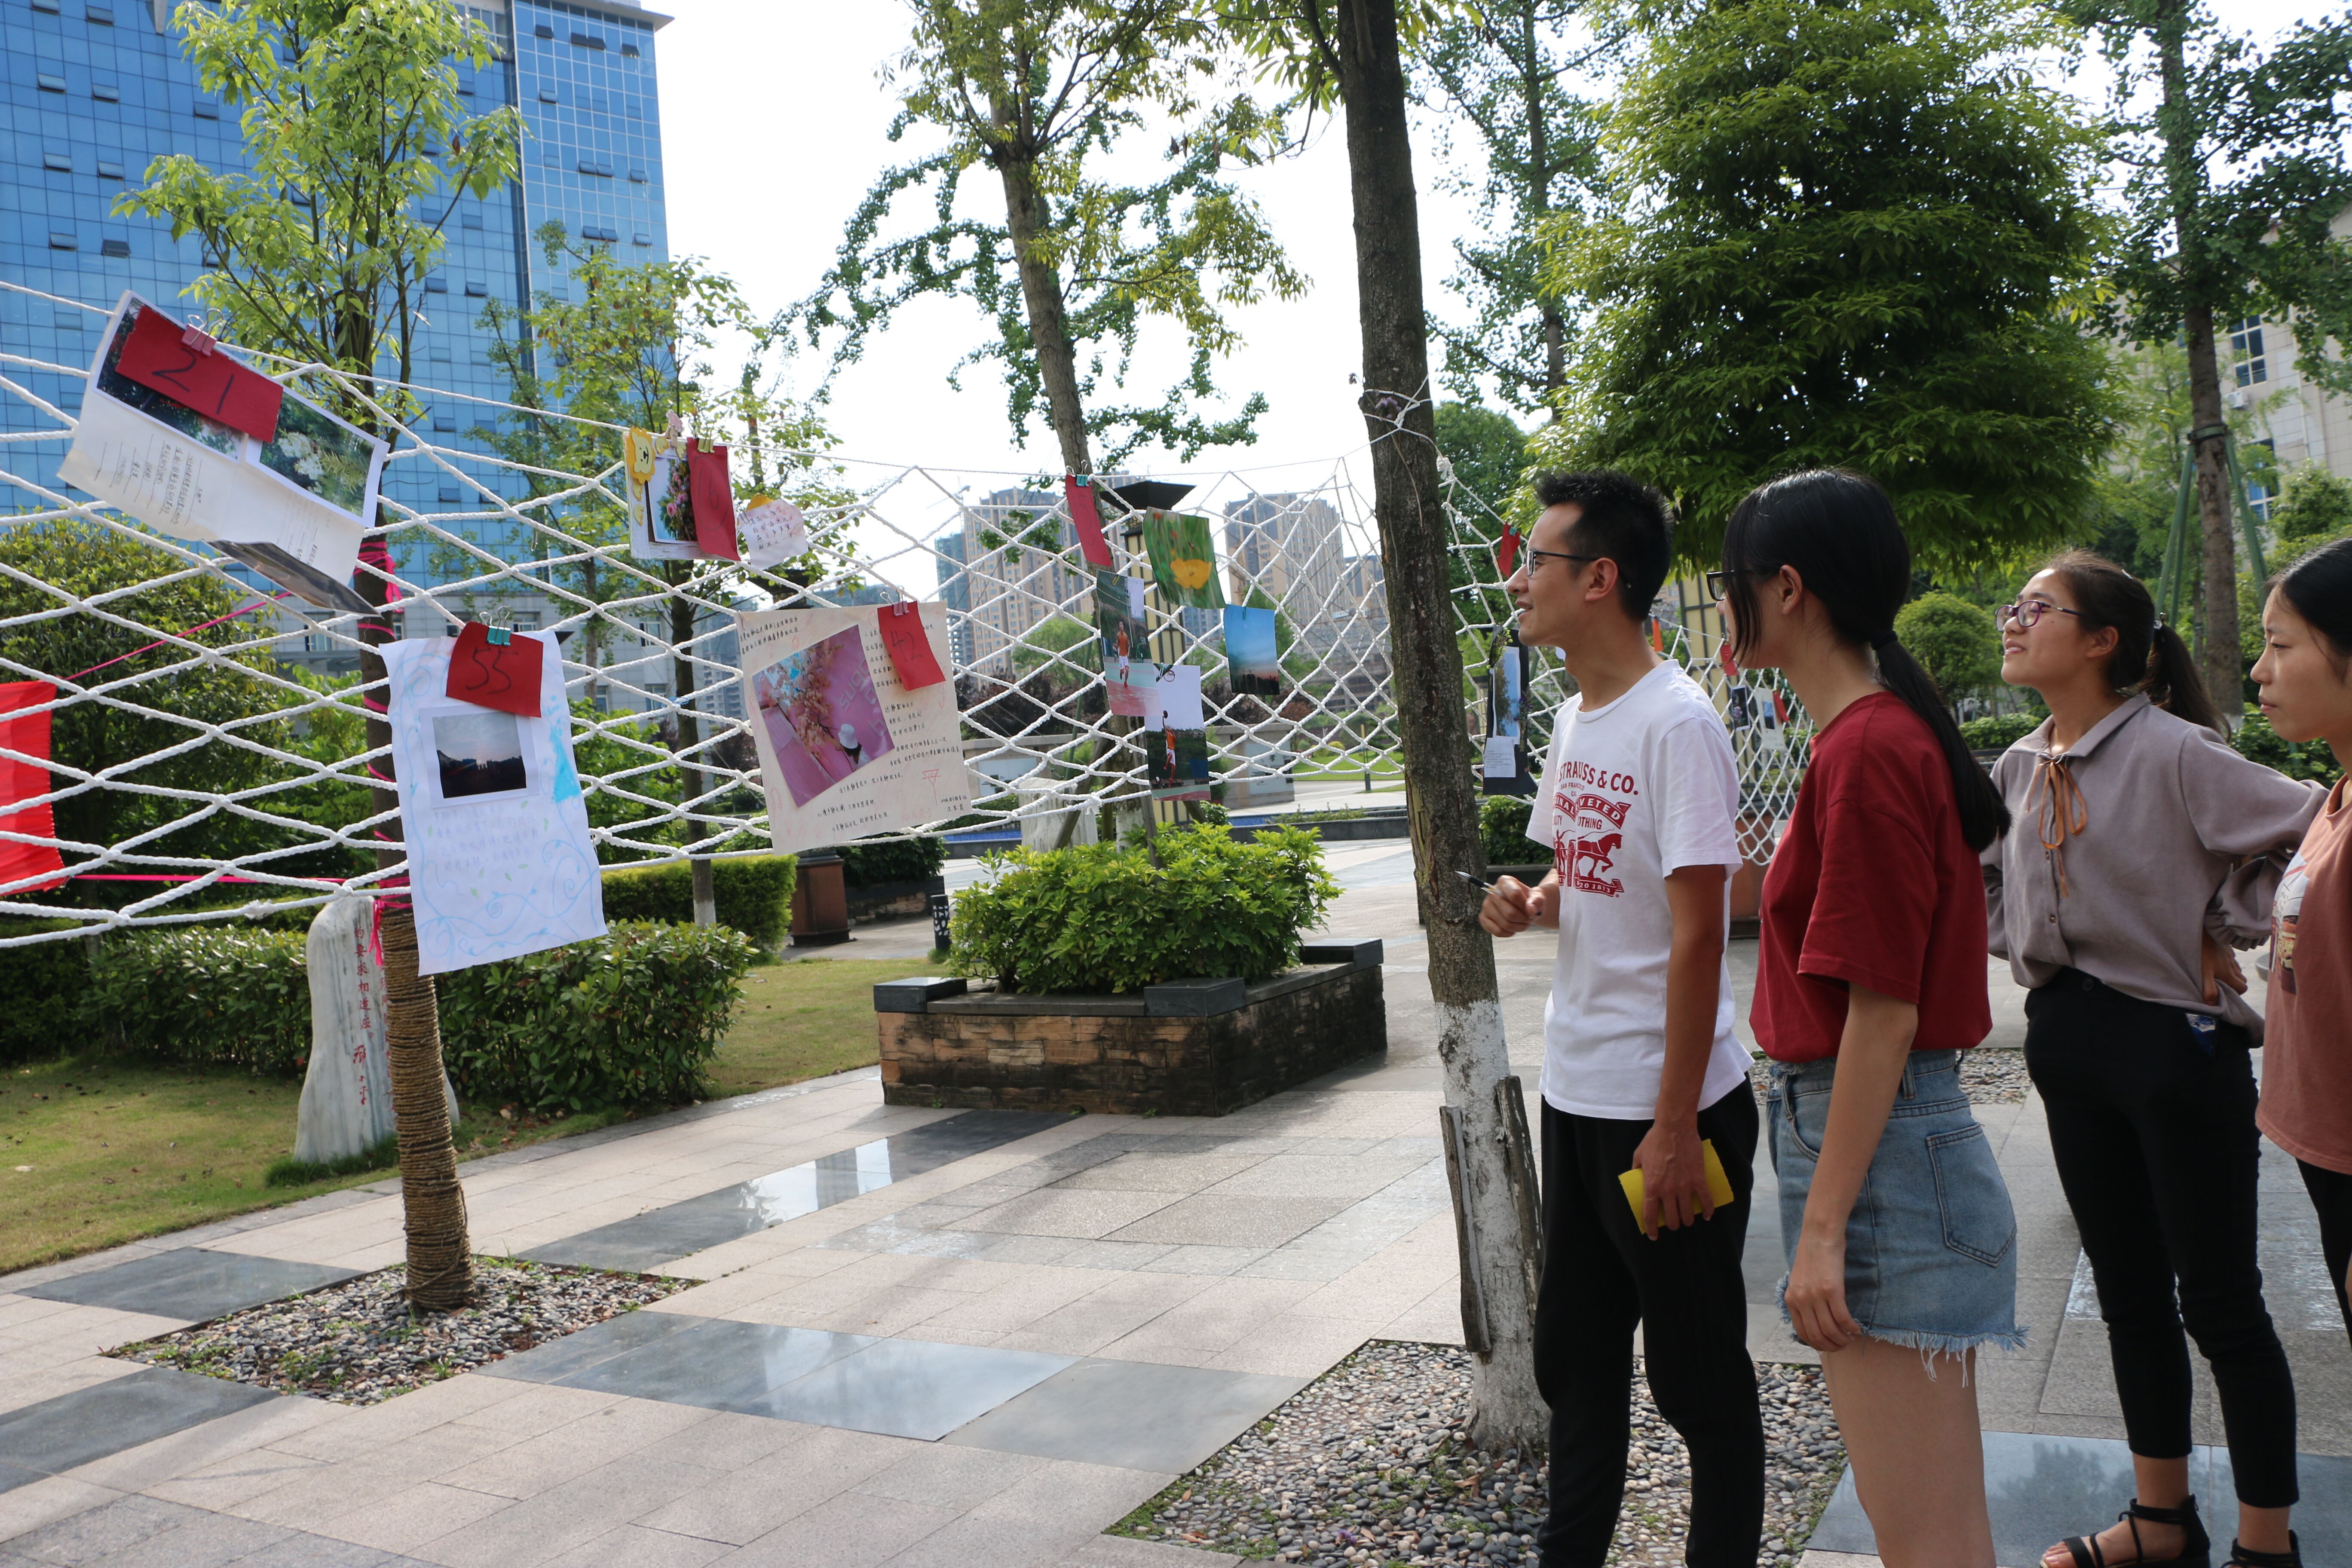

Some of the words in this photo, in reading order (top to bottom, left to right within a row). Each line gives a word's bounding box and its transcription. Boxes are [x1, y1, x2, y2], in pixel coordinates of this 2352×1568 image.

[152, 347, 234, 414] 21
[699, 467, 719, 510] 16
[890, 630, 923, 662] 42
[465, 646, 518, 695] 55
[1559, 761, 1596, 785] STRAUSS
[1597, 770, 1608, 789] &
[1611, 773, 1638, 795] CO.
[1592, 884, 1611, 893] 1873
[354, 927, 374, 1037] 的要求相适应。
